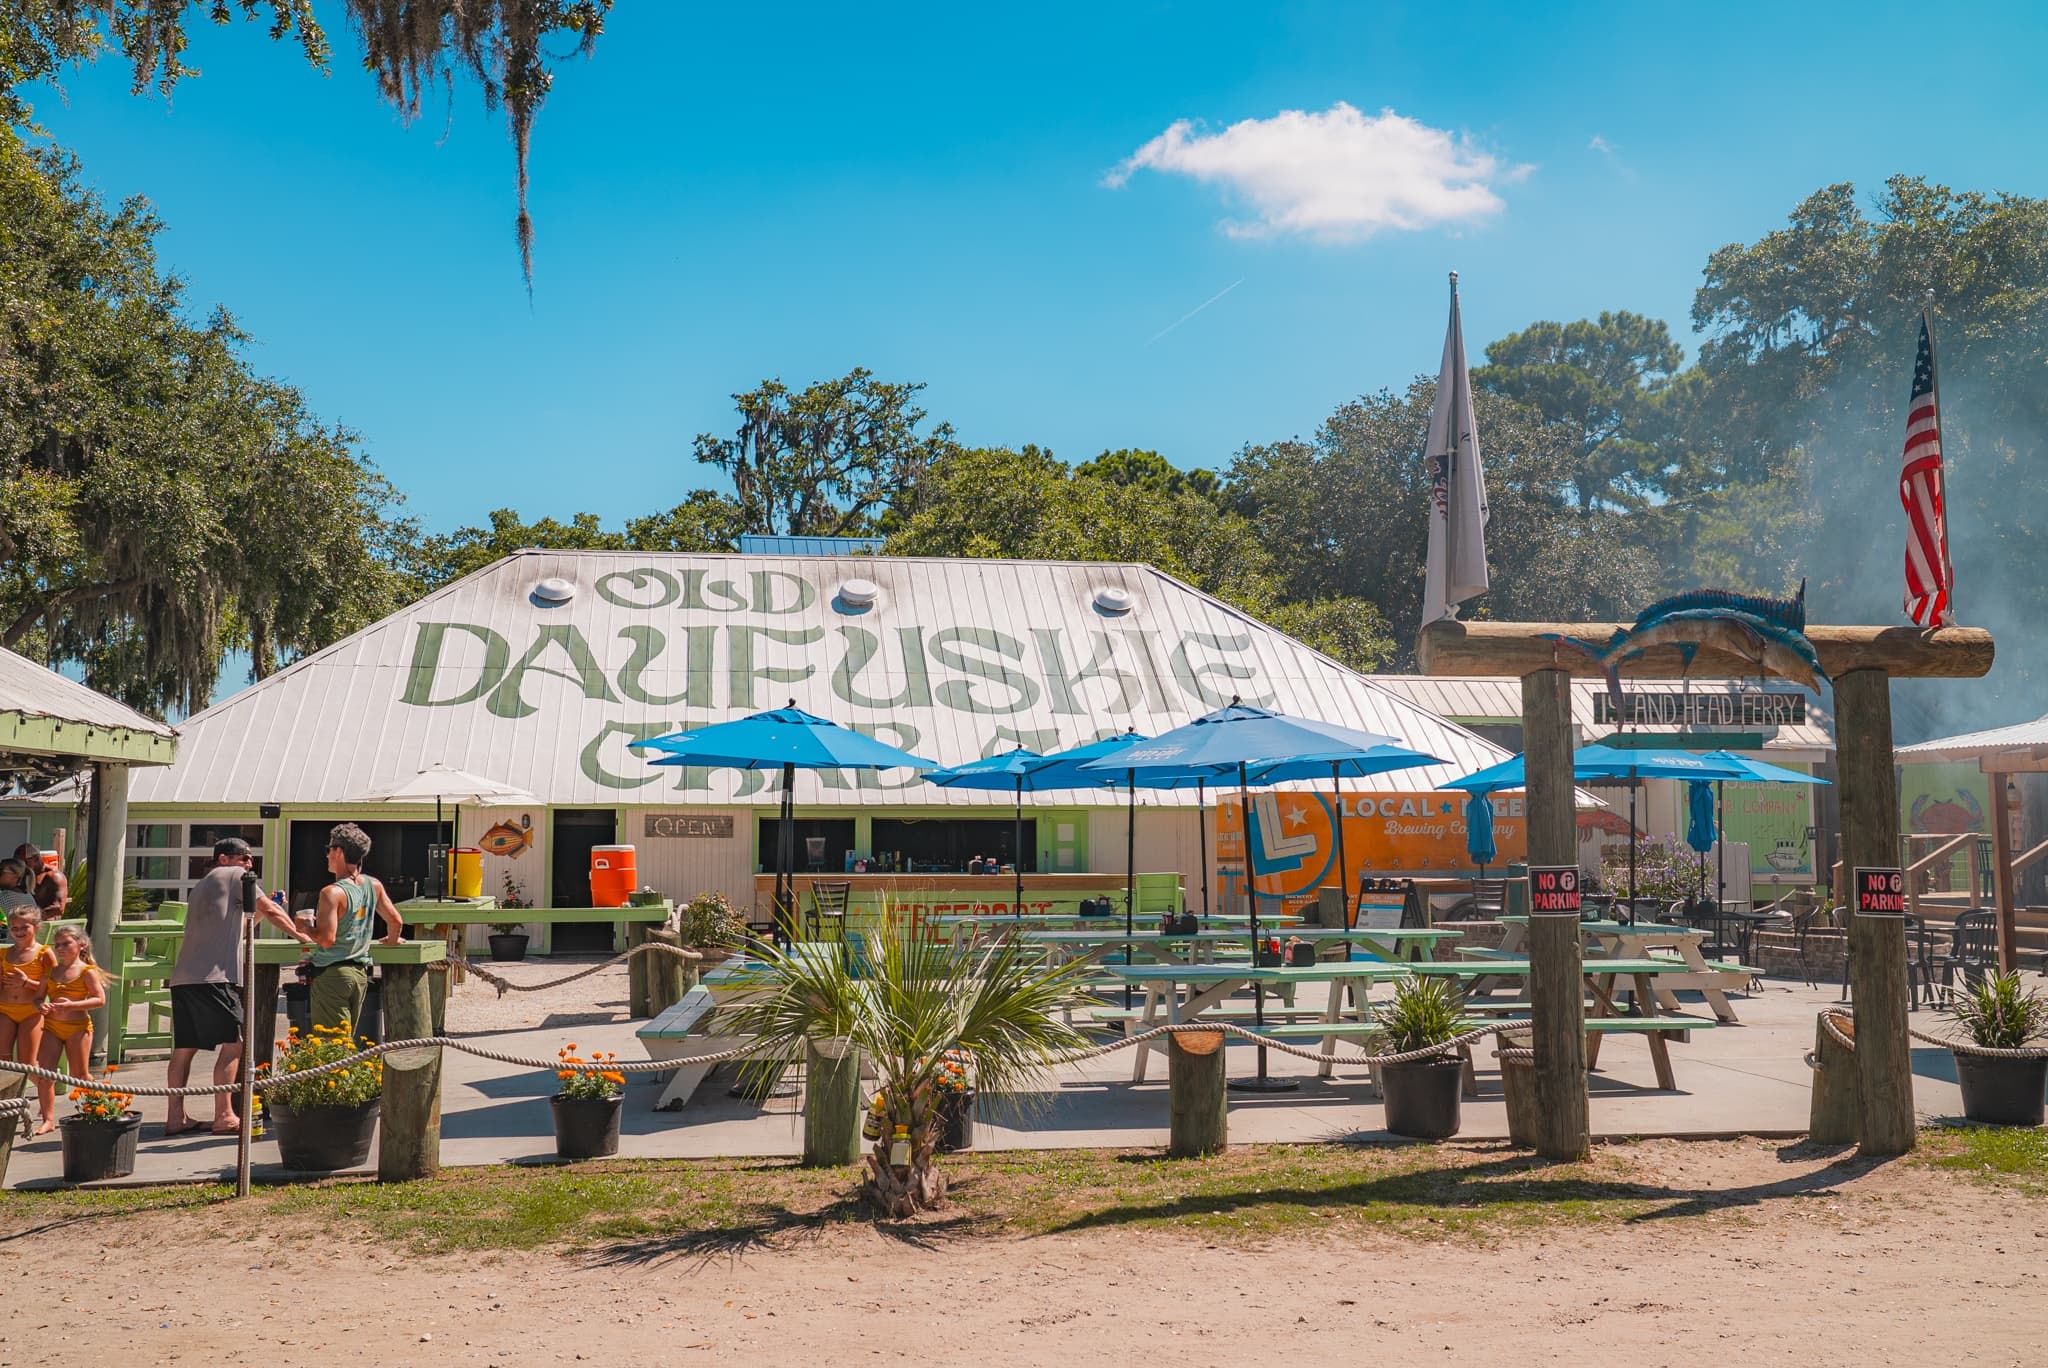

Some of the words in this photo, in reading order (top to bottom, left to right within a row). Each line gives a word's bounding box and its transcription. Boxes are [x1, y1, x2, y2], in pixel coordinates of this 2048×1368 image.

[594, 567, 816, 615] OLD
[398, 621, 1276, 719] DAUFUSKIE
[1683, 694, 1734, 725] HEAD
[1742, 694, 1799, 725] FERRY
[579, 719, 926, 798] CRB
[1340, 798, 1436, 818] LOCAL
[654, 816, 716, 838] OPEN
[1384, 820, 1447, 840] Brewing
[1449, 820, 1516, 840] Cony
[1538, 872, 1557, 891] NO
[1867, 873, 1887, 892] NO
[1861, 892, 1905, 911] PARKIN
